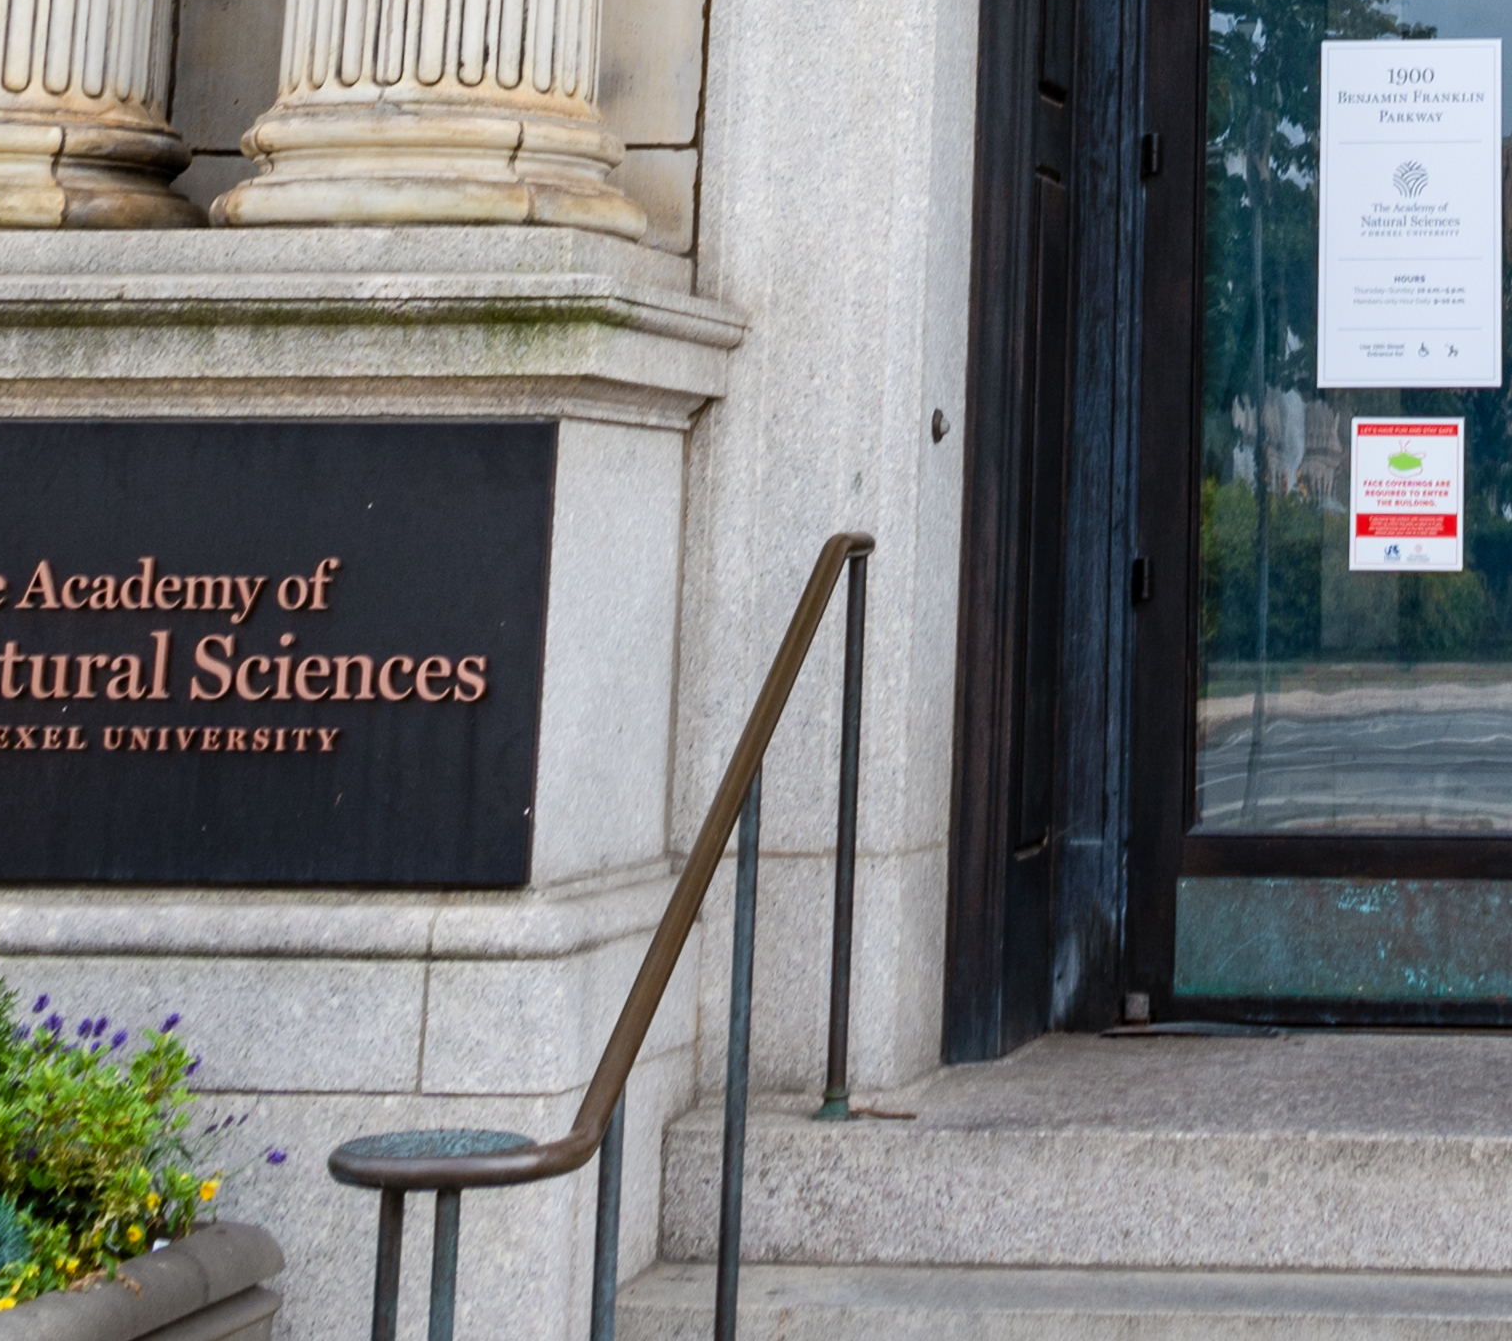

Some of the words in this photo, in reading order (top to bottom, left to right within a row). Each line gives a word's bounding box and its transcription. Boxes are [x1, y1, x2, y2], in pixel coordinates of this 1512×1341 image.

[1387, 67, 1435, 86] 1900
[1372, 202, 1390, 213] The
[1393, 202, 1435, 215] Academy
[1438, 201, 1449, 212] of
[1360, 216, 1407, 228] Natural
[1410, 215, 1460, 227] Sciences
[1394, 275, 1426, 283] HOURS
[14, 556, 266, 623] Academy
[276, 556, 340, 611] of
[190, 633, 487, 703] Sciences
[103, 725, 340, 753] UNIVERSITY
